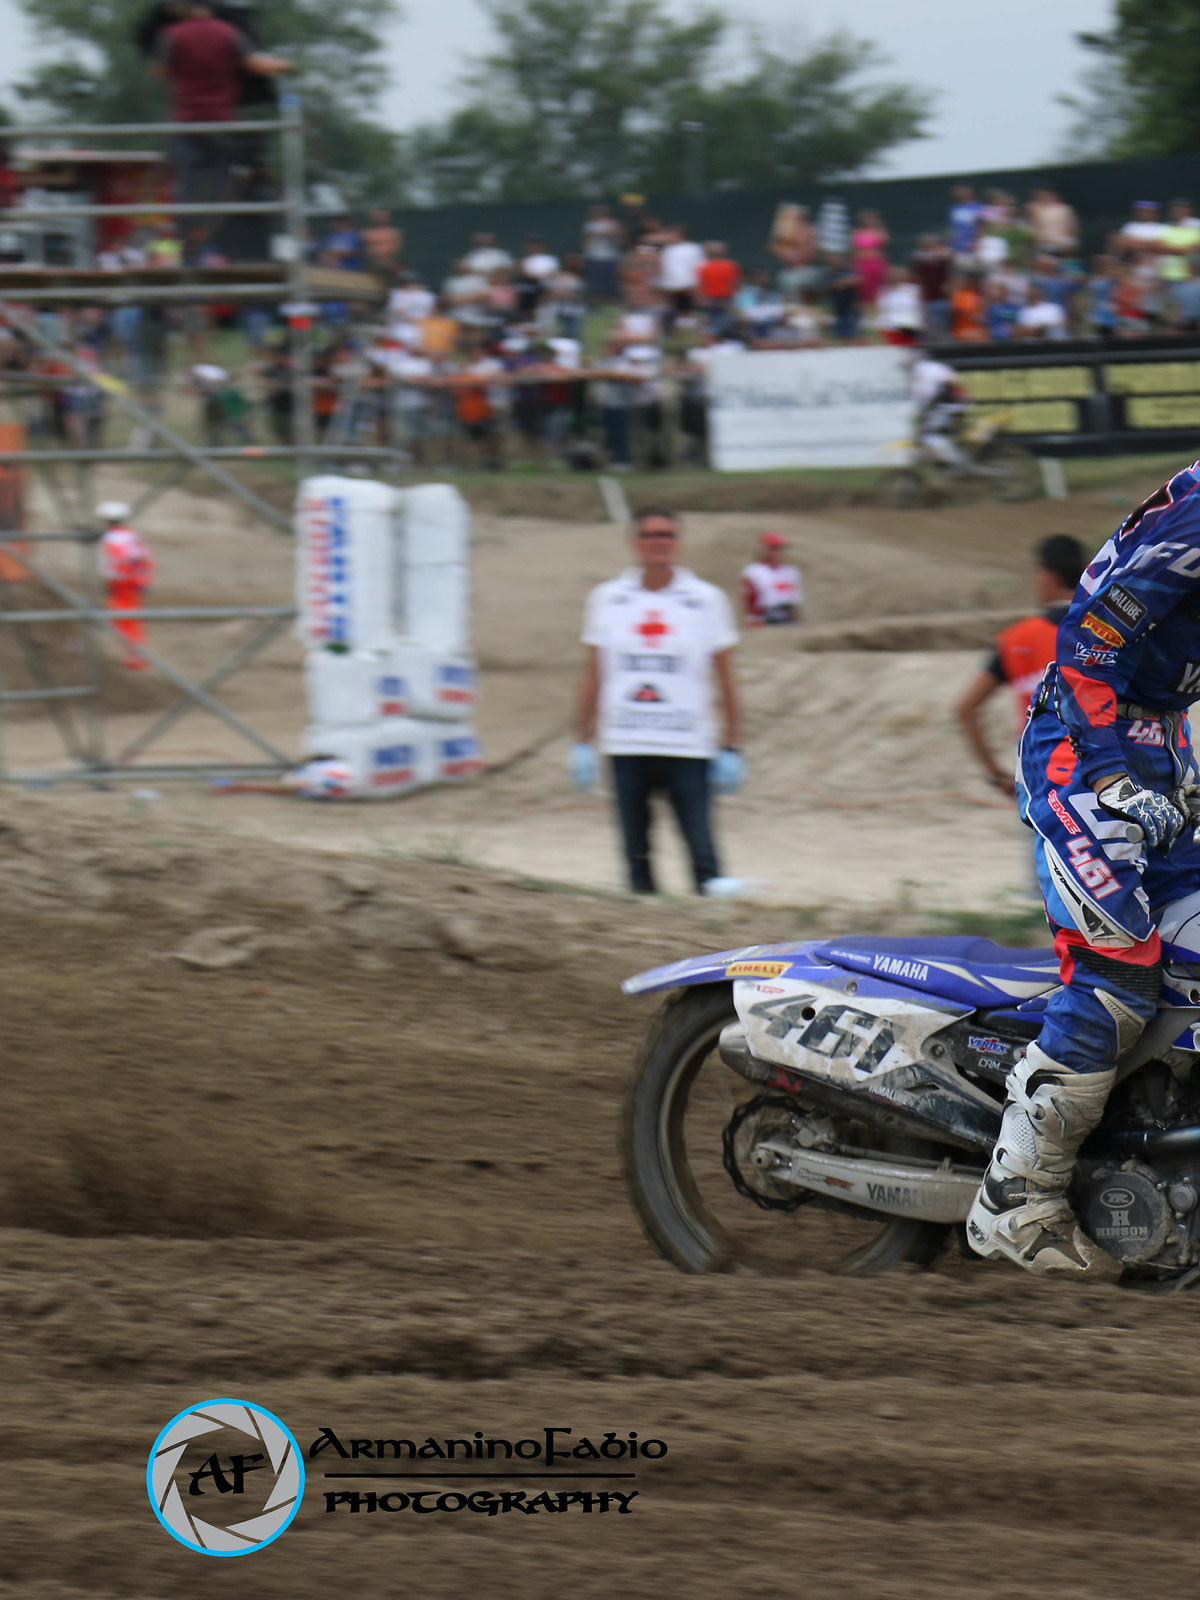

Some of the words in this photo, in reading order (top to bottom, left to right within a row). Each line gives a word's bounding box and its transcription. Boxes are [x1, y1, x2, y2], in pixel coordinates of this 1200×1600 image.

[1066, 835, 1123, 900] 461
[731, 963, 784, 976] PIRELLI
[872, 954, 929, 982] YAMAHA
[747, 994, 896, 1074] 461
[969, 1037, 1007, 1054] VERTEX
[1095, 1226, 1148, 1237] HINSON
